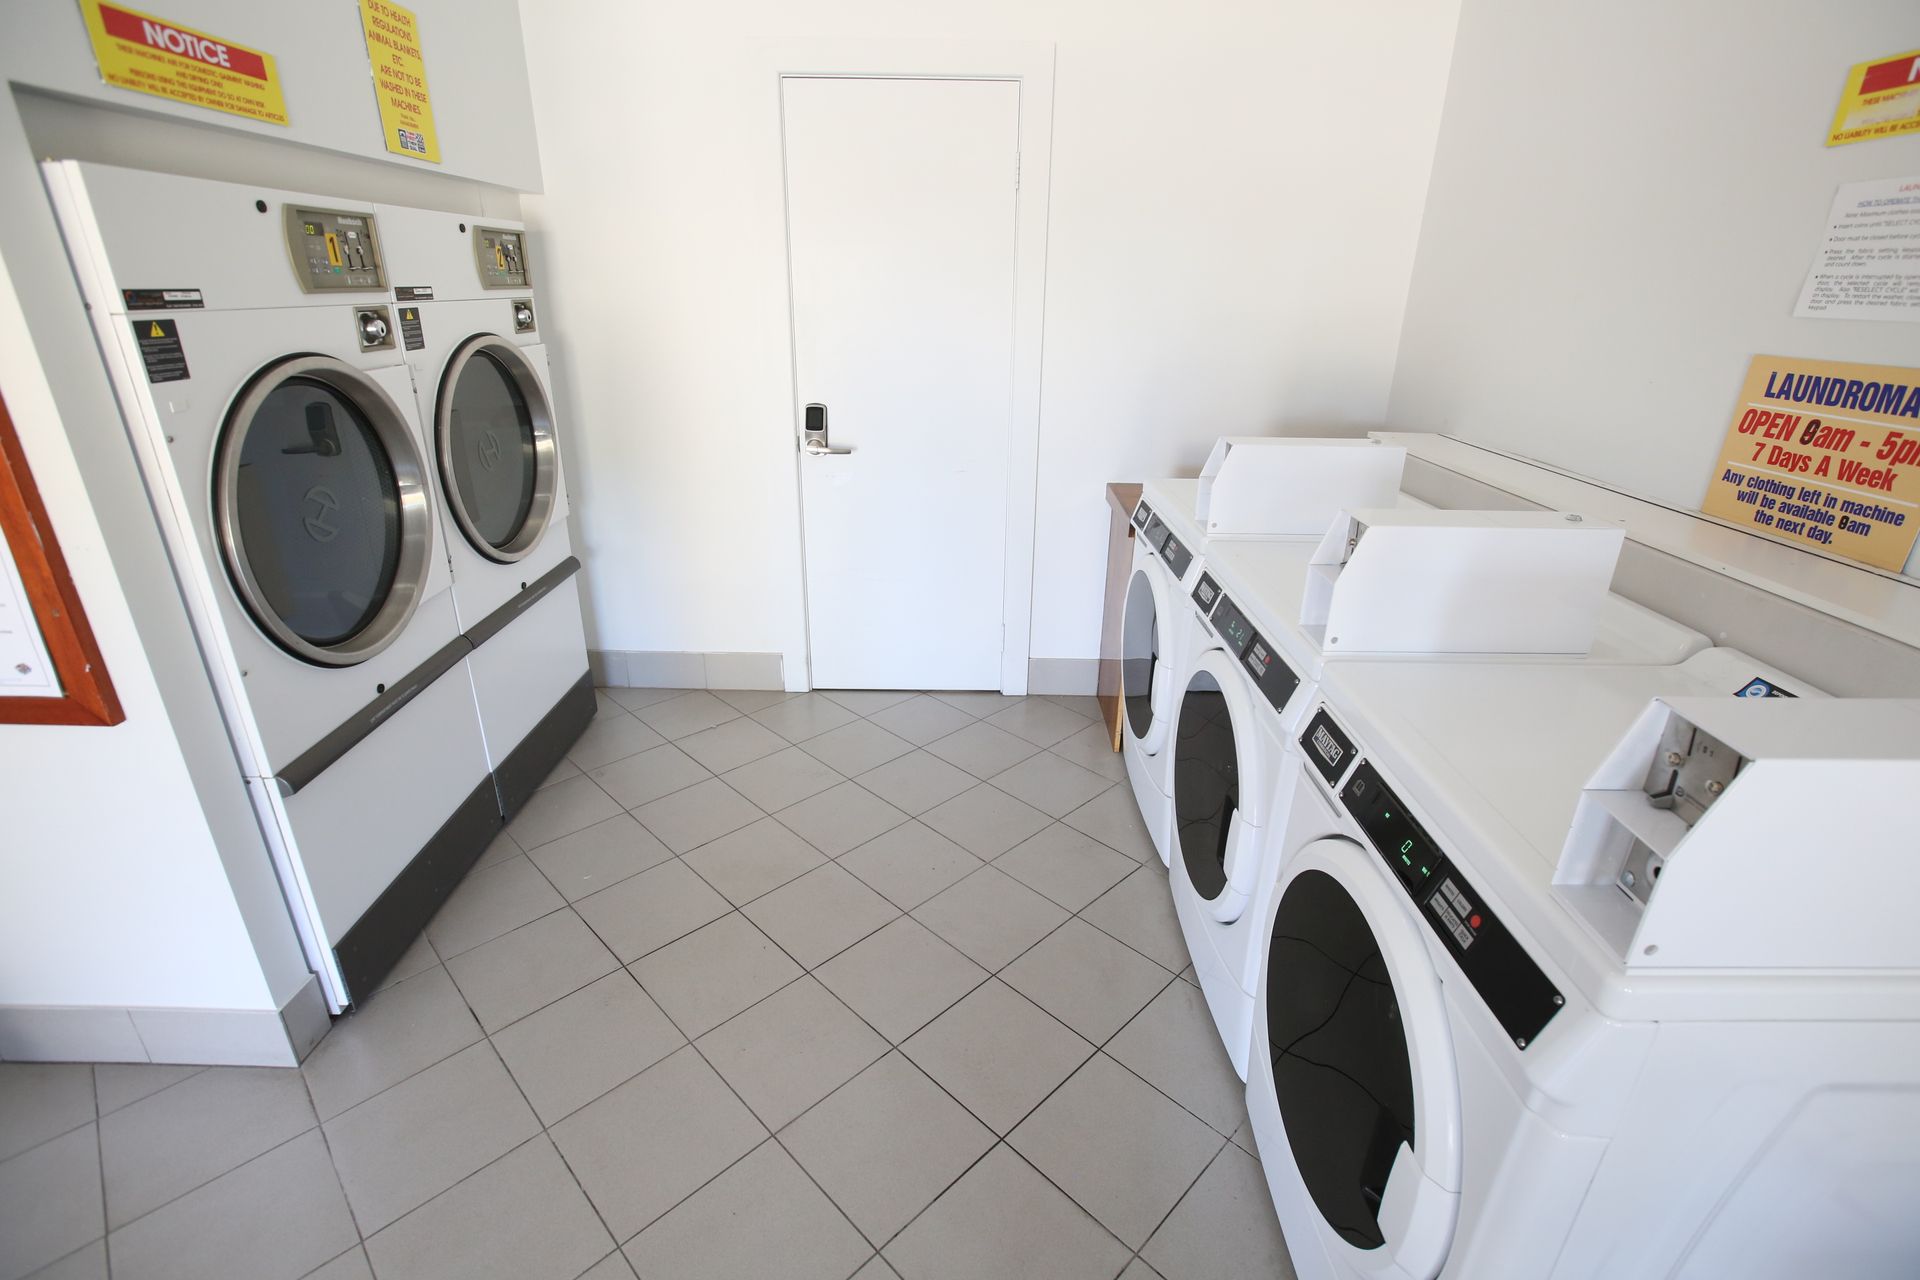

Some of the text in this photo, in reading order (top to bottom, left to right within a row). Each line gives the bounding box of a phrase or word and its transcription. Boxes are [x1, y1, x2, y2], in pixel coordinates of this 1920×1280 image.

[367, 0, 411, 27] DUE TO HEALTH
[372, 16, 412, 42] REGULATIONS
[142, 20, 231, 68] NOTICE
[368, 29, 393, 48] ANIMAL
[379, 79, 427, 103] WASHED IN THESE
[380, 64, 422, 88] ARE NOT TO BE
[1764, 371, 1920, 418] LAUNDROMA
[1738, 408, 1801, 442] OPEN
[1859, 440, 1872, 449] -
[1752, 442, 1899, 492] 7 Days A Week
[1722, 469, 1905, 527] Any clothing left in machine
[1736, 490, 1757, 505] will
[1760, 496, 1776, 510] be
[1778, 500, 1836, 527] available
[1754, 510, 1833, 545] the next day.
[1315, 728, 1340, 759] MAYTAG
